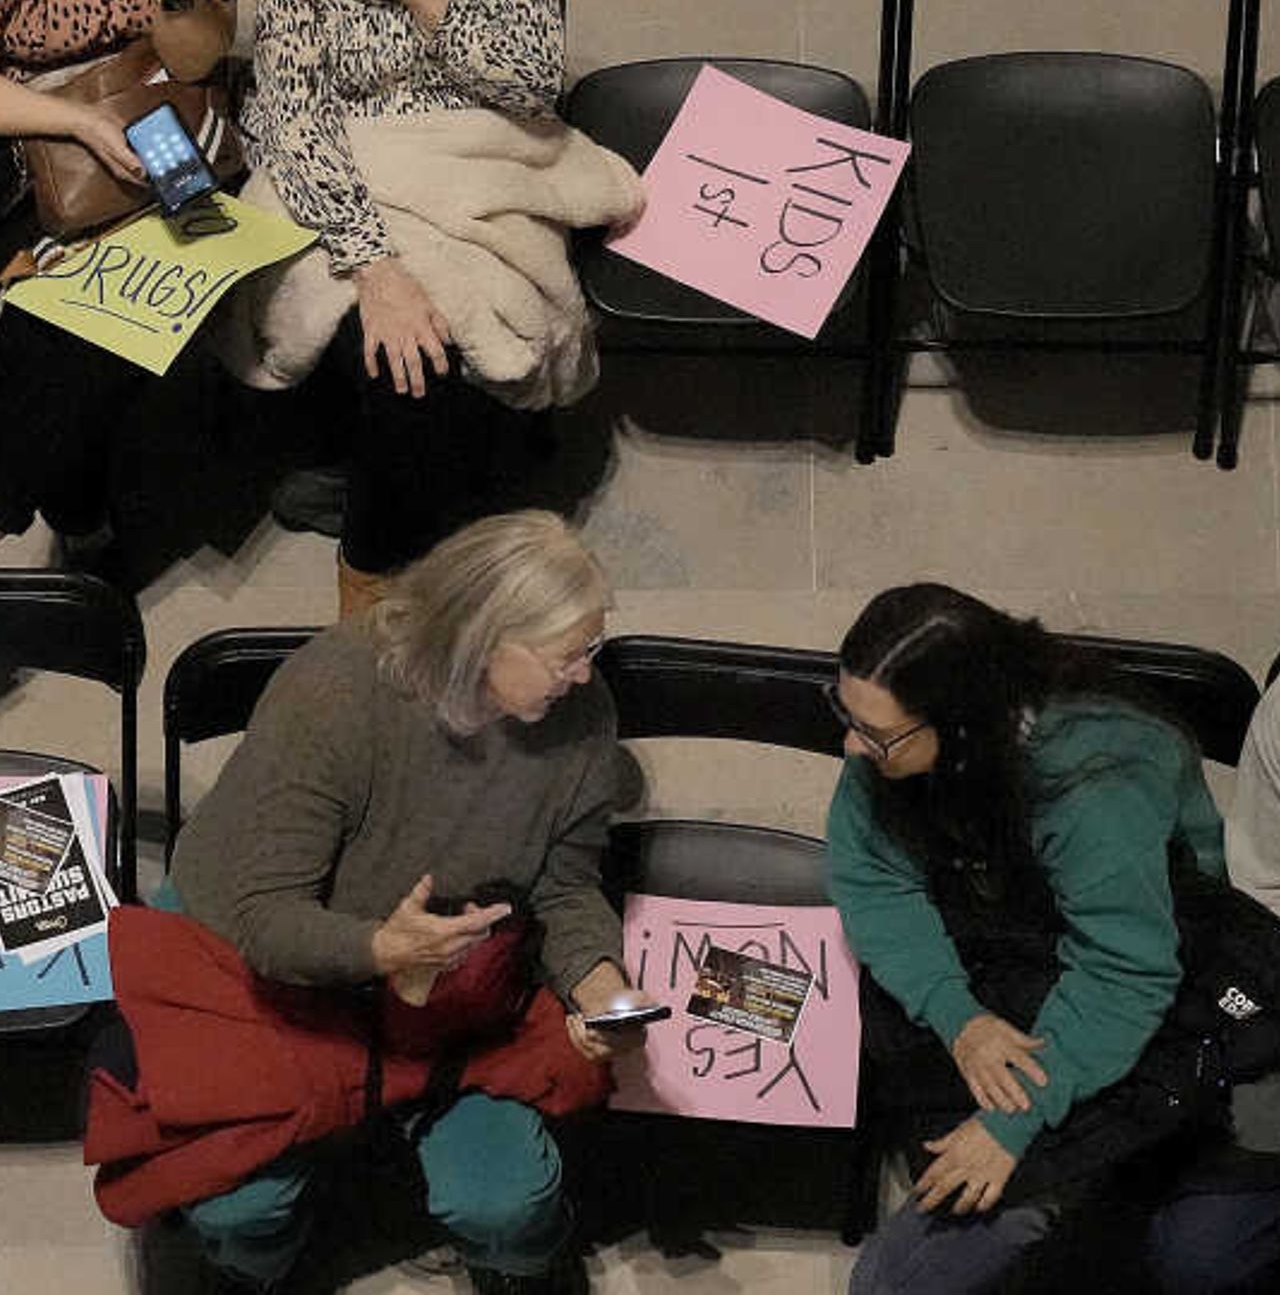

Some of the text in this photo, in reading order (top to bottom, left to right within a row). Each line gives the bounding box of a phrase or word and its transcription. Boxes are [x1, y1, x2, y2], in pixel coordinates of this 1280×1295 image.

[686, 153, 771, 228] 1st
[759, 137, 892, 279] KIDS
[1, 882, 91, 925] PASTORS
[685, 1024, 821, 1112] YES
